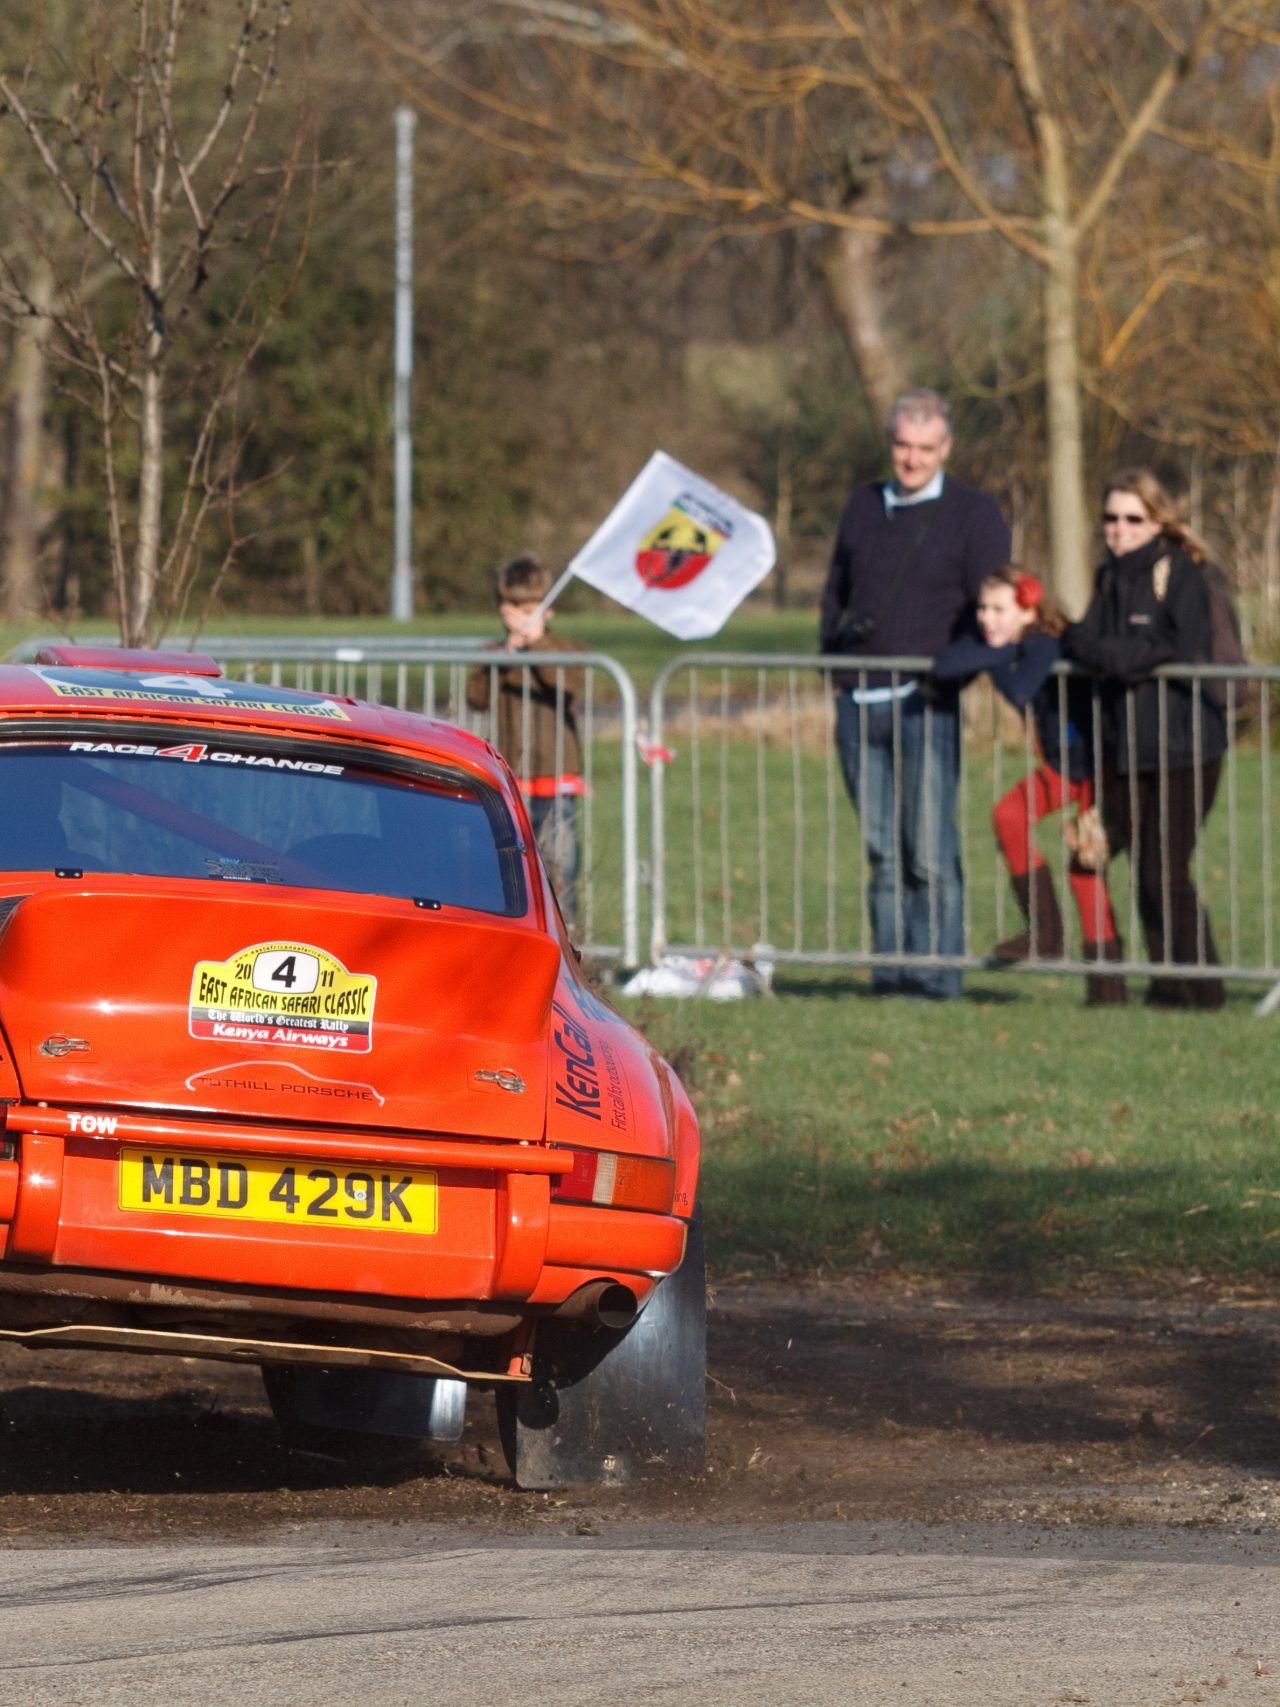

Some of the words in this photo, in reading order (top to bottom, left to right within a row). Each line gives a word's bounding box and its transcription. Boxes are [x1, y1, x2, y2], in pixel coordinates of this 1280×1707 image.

[139, 675, 234, 698] 4
[57, 685, 104, 697] EAST
[112, 690, 195, 703] AFRICAN
[200, 698, 266, 710] SAFARI
[272, 704, 343, 719] CLASSIC
[235, 963, 253, 981] 20
[271, 956, 297, 988] 4
[321, 970, 335, 988] 11
[199, 972, 227, 1004] EAST
[230, 986, 277, 1011] AFRICAN
[281, 995, 321, 1015] SAFARI
[325, 985, 369, 1016] CLASSIC
[208, 1009, 228, 1021] The
[230, 1012, 273, 1025] World's
[276, 1016, 317, 1029] Greatest
[320, 1020, 349, 1034] Rally
[213, 1023, 270, 1041] Kenya
[272, 1030, 349, 1047] Airways
[552, 1001, 602, 1121] KenCall
[197, 1077, 275, 1091] TUTHILL
[281, 1083, 373, 1100] PORSCHE
[67, 1112, 118, 1135] TOW
[142, 1155, 249, 1210] MBD
[269, 1166, 413, 1223] 429K
